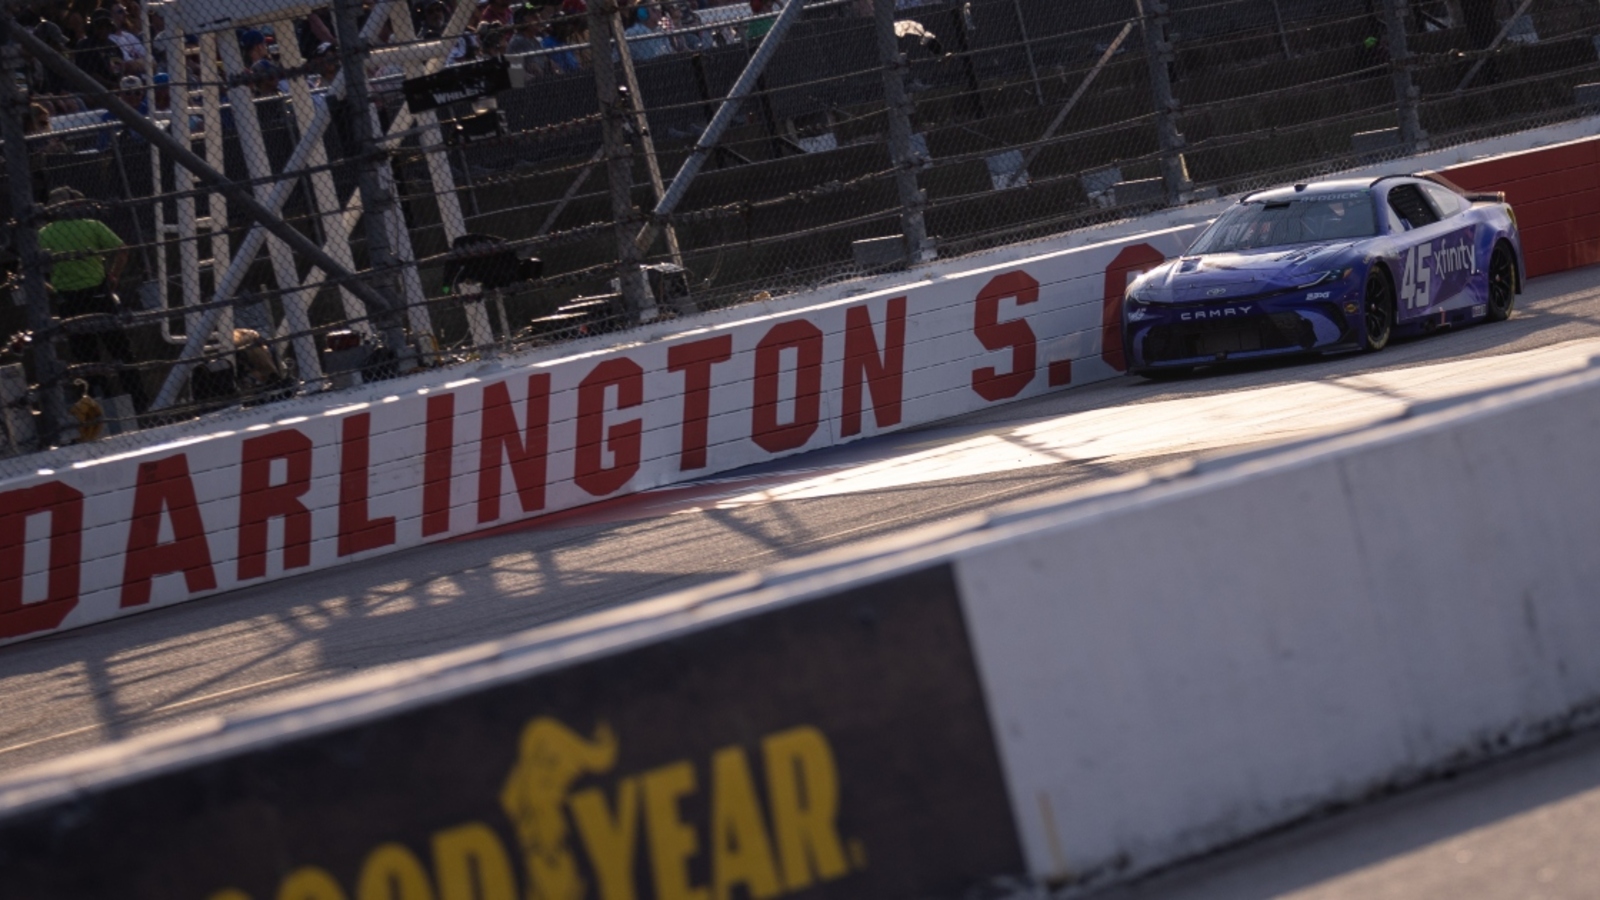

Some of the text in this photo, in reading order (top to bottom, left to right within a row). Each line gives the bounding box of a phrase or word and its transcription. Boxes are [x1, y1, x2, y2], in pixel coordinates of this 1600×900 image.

[1180, 305, 1252, 320] CAMRY
[1401, 237, 1475, 310] 45 xfinity
[0, 296, 908, 639] DARLINGTON
[972, 270, 1071, 402] S.
[205, 726, 848, 900] DYEAR
